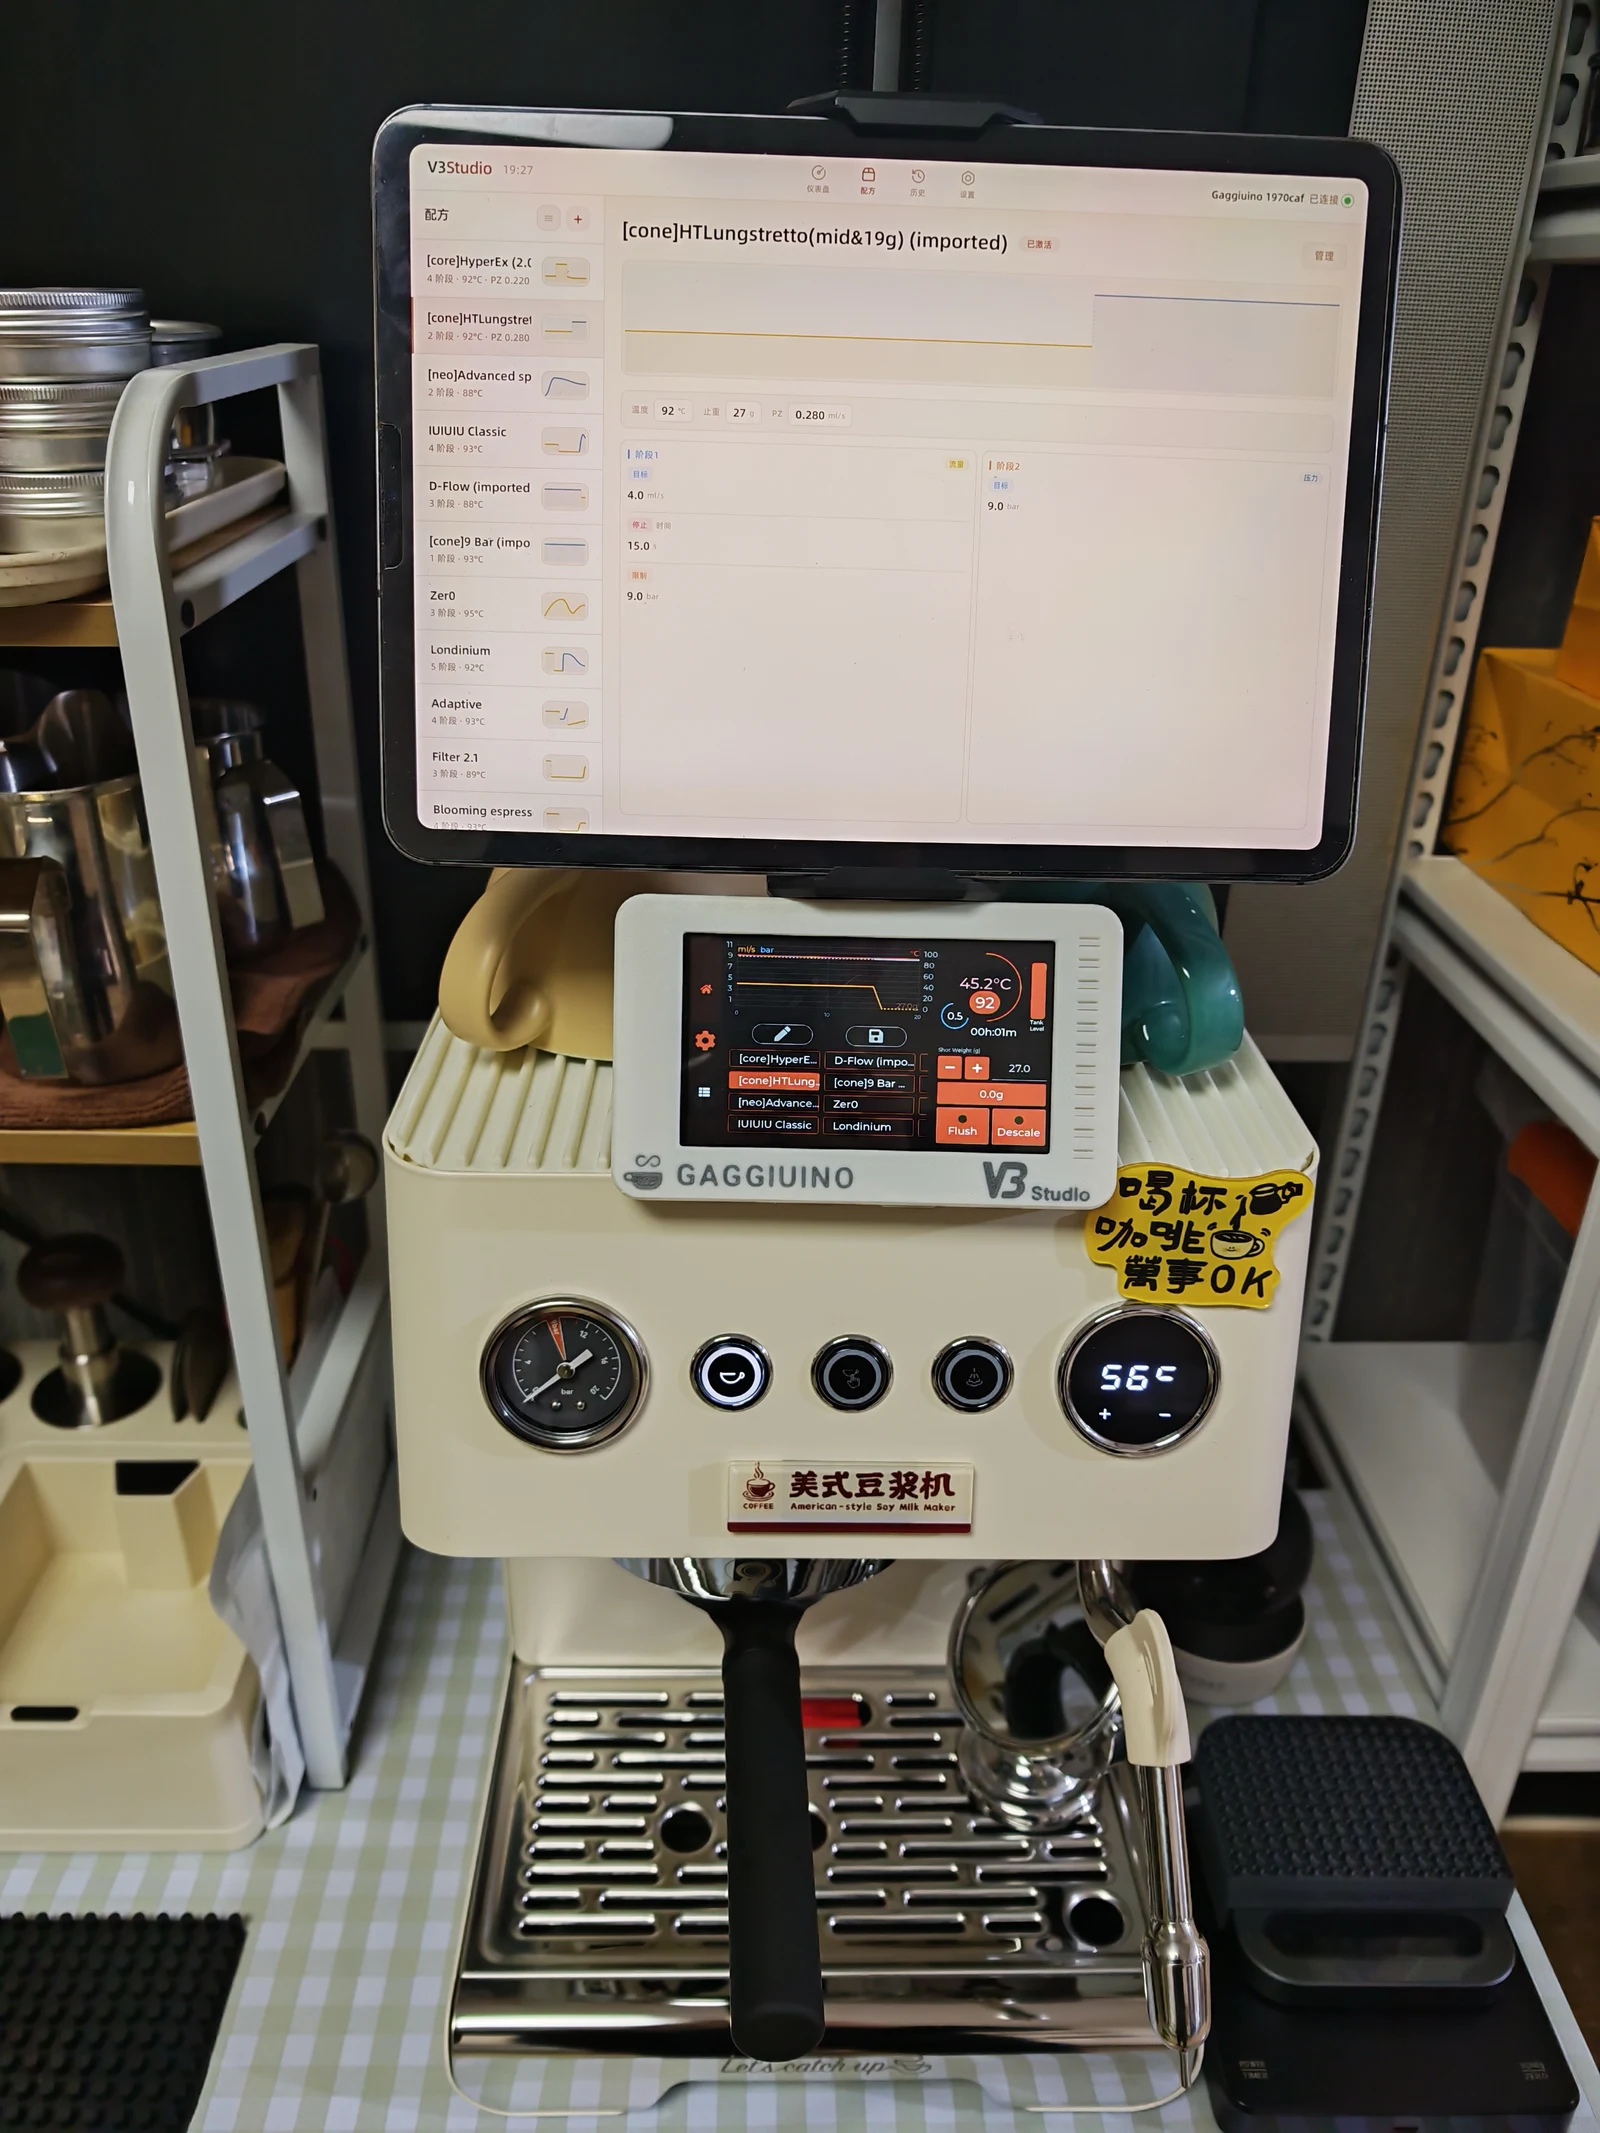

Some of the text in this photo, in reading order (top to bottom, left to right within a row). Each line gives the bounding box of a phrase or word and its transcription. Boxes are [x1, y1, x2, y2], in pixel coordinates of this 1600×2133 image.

[428, 160, 493, 176] V3Studio
[503, 164, 533, 176] 19:27
[860, 186, 875, 195] 配方
[910, 188, 926, 197] 历史
[960, 190, 975, 199] 设置
[1211, 190, 1339, 205] Gaggiuino 1970caf 已连接
[424, 208, 449, 222] 配方
[623, 221, 1008, 254] [cone]HTLungstretto(mid&19g) (imported)
[1027, 239, 1053, 250] 已激活
[427, 254, 508, 269] [core]HyperEx
[1314, 250, 1335, 262] 管理
[427, 273, 530, 285] 4 阶段 92°C PZ 0.220
[428, 332, 433, 340] 2
[435, 331, 454, 341] 阶段
[462, 332, 483, 341] 92°C
[505, 334, 530, 342] 0.280
[428, 369, 532, 384] [neo]Advanced sp
[428, 388, 483, 397] 2 阶段 88°C
[661, 406, 675, 416] 92
[703, 407, 720, 417] 止重
[733, 408, 746, 418] 27
[772, 410, 783, 418] PZ
[795, 410, 825, 420] 0.280
[828, 412, 846, 420] ml/s
[468, 426, 507, 437] Classic
[428, 443, 483, 453] 4 阶段 93°C
[633, 470, 648, 479] 目标
[1303, 474, 1318, 483] 压力
[429, 481, 530, 494] D-Flow (imported
[994, 481, 1009, 490] 目标
[627, 490, 644, 500] 4.0
[437, 499, 455, 508] 阶段
[463, 500, 483, 509] 88°C
[987, 501, 1020, 511] 9.0 bar
[632, 521, 671, 530] 停止 时间
[429, 536, 530, 549] [cone]9 Bar (impo
[627, 541, 650, 551] 15.0
[437, 554, 483, 563] 阶段 93°C
[632, 571, 647, 580] 限制
[627, 591, 643, 601] 9.0
[430, 608, 484, 618] 3 阶段 95°C
[431, 645, 491, 656] Londinium
[438, 662, 456, 672] 阶段
[464, 664, 484, 672] 92°C
[431, 699, 482, 711] Adaptive
[439, 716, 457, 726] 阶段
[465, 717, 485, 726] 93°C
[432, 752, 479, 763] Filter 2.1
[432, 769, 486, 779] 3 阶段 89°C
[433, 804, 533, 818] Blooming espress
[959, 977, 1012, 991] 45.2°C
[975, 996, 995, 1009] 92
[947, 1011, 963, 1021] 0.5
[970, 1027, 1017, 1038] 00h:01m
[834, 1055, 874, 1066] D-Flow
[1008, 1064, 1031, 1073] 27.0
[834, 1077, 896, 1089] [cone]9 Bar
[979, 1089, 1004, 1100] 0.0g
[774, 1120, 812, 1129] Classic
[833, 1121, 892, 1131] Londinium
[948, 1126, 978, 1136] Flush
[997, 1127, 1041, 1138] Descale
[676, 1163, 854, 1190] GAGGIUINO
[982, 1161, 1091, 1203] V3 Studio
[1118, 1170, 1228, 1216] 喝杯
[1095, 1216, 1206, 1254] 咖啡
[579, 1330, 588, 1339] 12
[601, 1356, 609, 1365] 16
[589, 1384, 600, 1395] 20
[788, 1470, 956, 1500] 美式豆浆机
[743, 1502, 774, 1510] COFFEE
[876, 1503, 895, 1513] Soy
[899, 1503, 920, 1511] Milk
[923, 1503, 956, 1512] Maker
[854, 2061, 887, 2075] up
